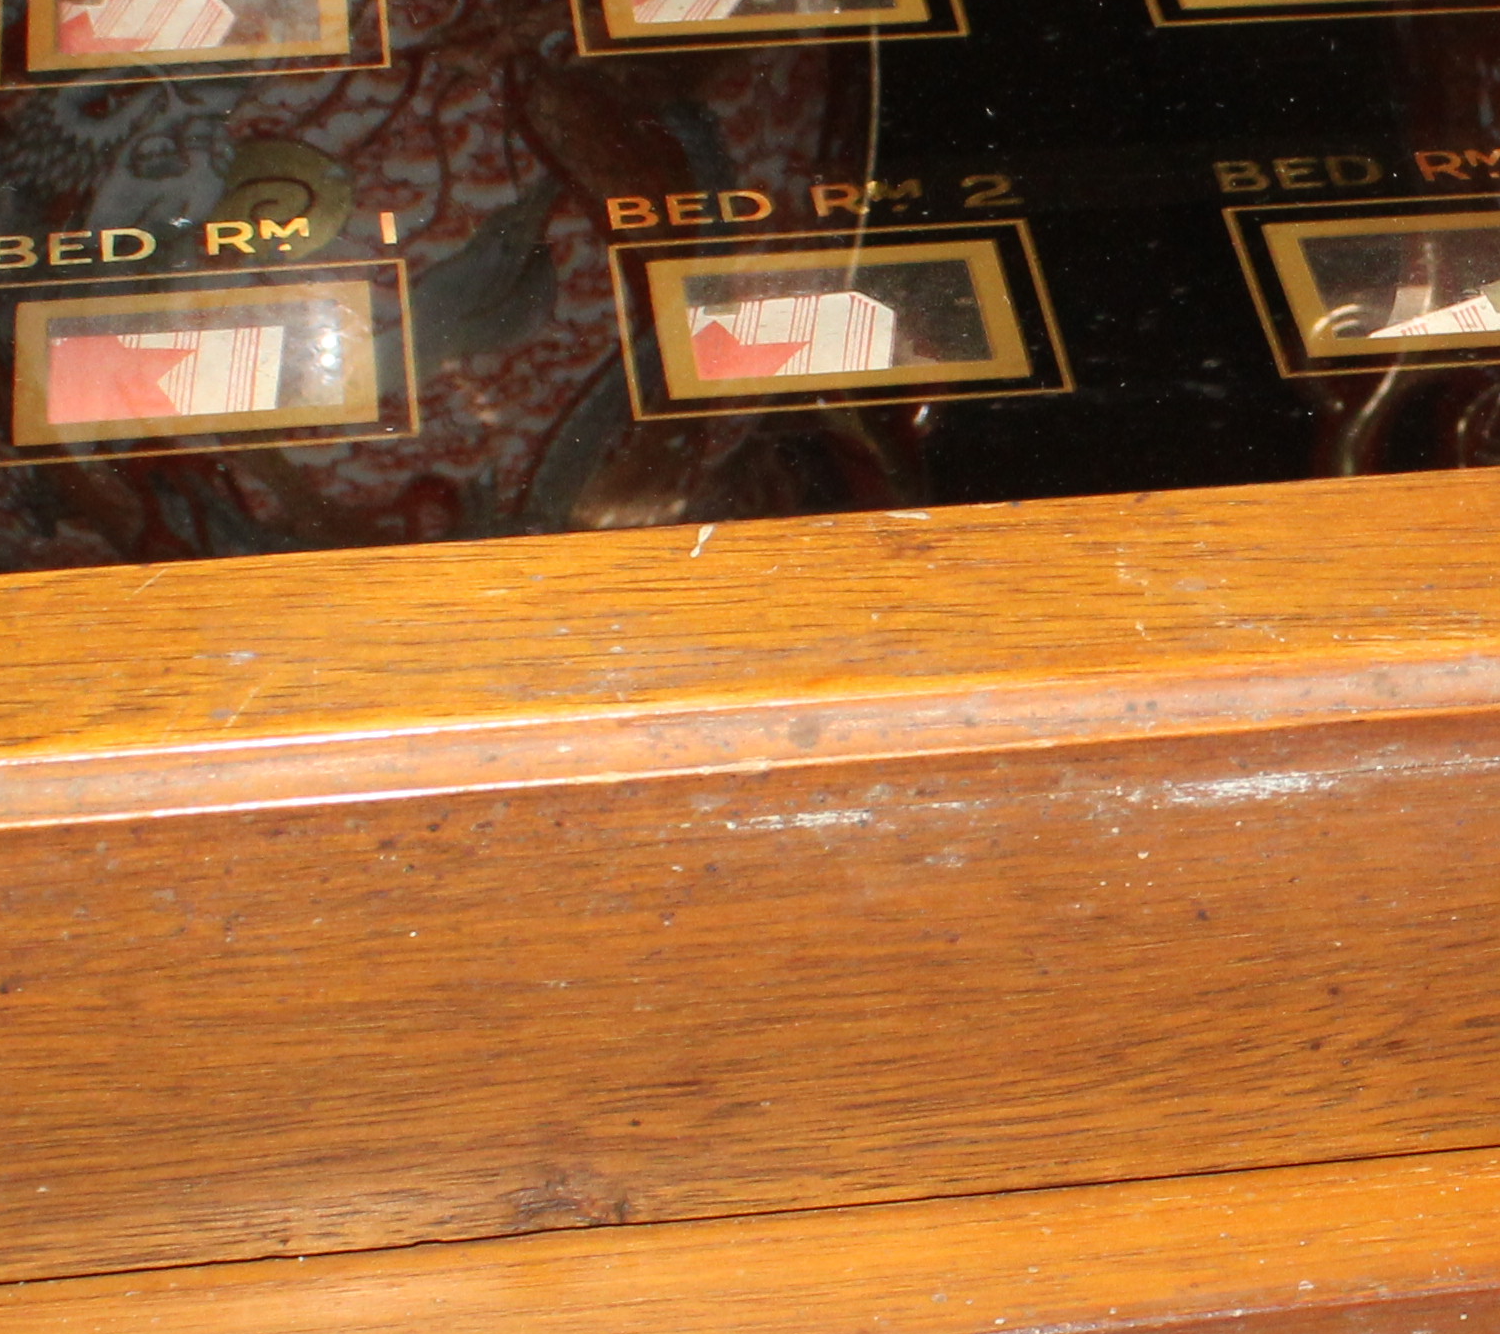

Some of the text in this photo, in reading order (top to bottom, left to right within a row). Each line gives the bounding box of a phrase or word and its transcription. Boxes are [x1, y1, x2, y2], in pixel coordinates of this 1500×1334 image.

[1212, 154, 1384, 194] BED
[605, 189, 774, 232] BED
[960, 173, 1026, 210] 2
